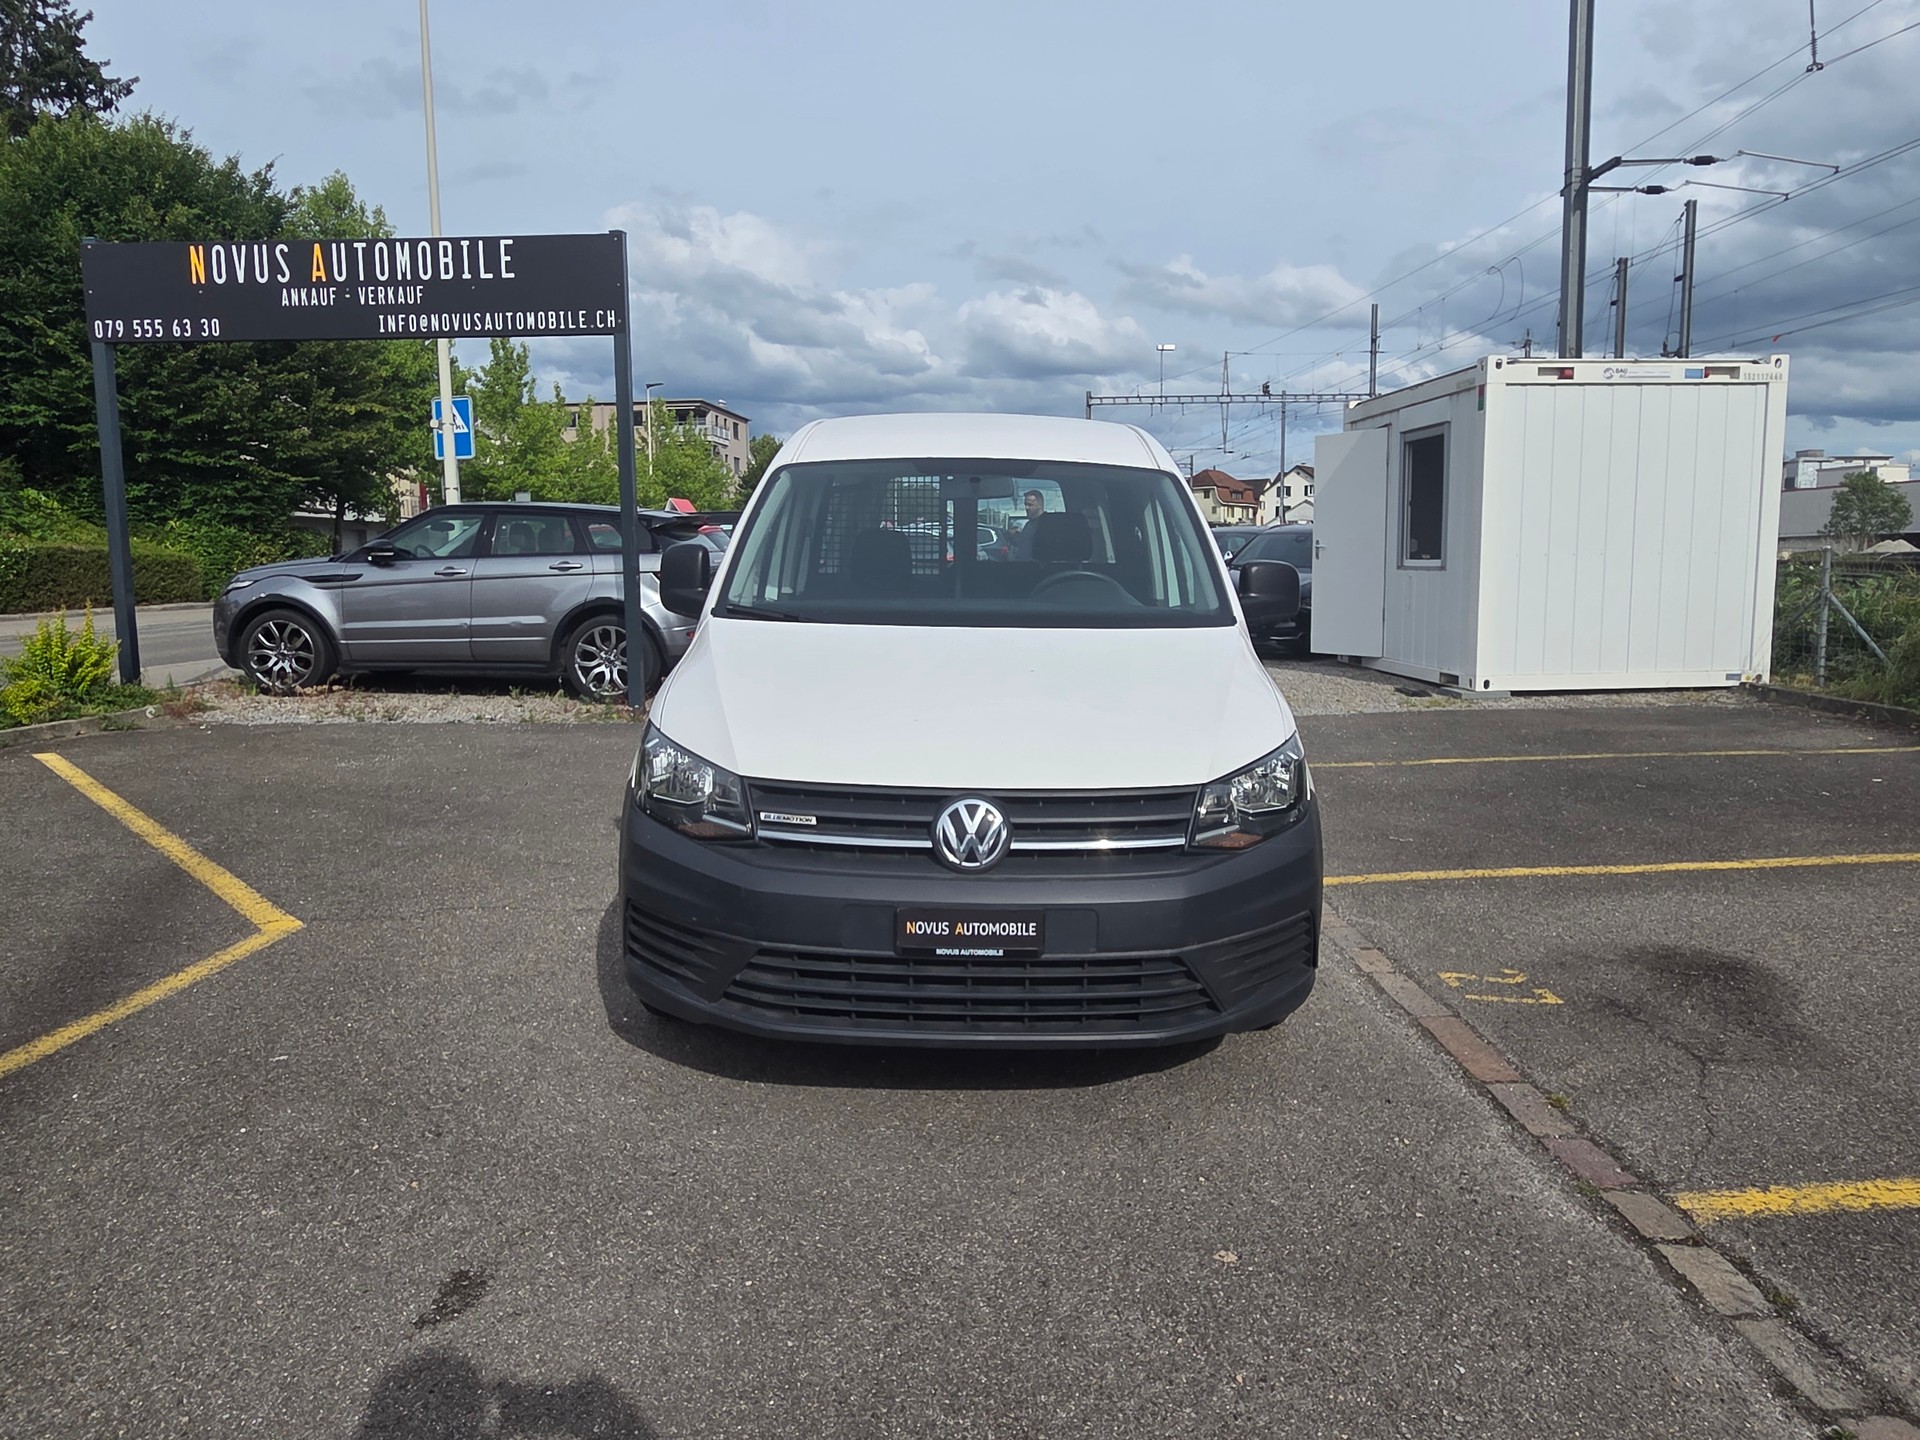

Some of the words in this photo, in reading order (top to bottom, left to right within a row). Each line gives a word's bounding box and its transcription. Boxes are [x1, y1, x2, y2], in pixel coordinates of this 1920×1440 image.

[189, 243, 290, 284] NOVUS
[311, 238, 515, 282] AUTOMOBILE
[281, 287, 337, 307] ANKAUF
[358, 285, 424, 306] VERKAUF
[94, 319, 124, 339] 079
[133, 318, 164, 338] 555
[172, 318, 192, 338] 63
[200, 318, 220, 337] 30
[378, 310, 616, 333] INFO@NOVUSAUTOMOBILE.CH
[763, 813, 813, 823] BLUEMOTION
[906, 921, 950, 935] NOVUS
[955, 922, 1037, 937] AUTOMOBILE
[960, 949, 1004, 957] AUTOMOBILE
